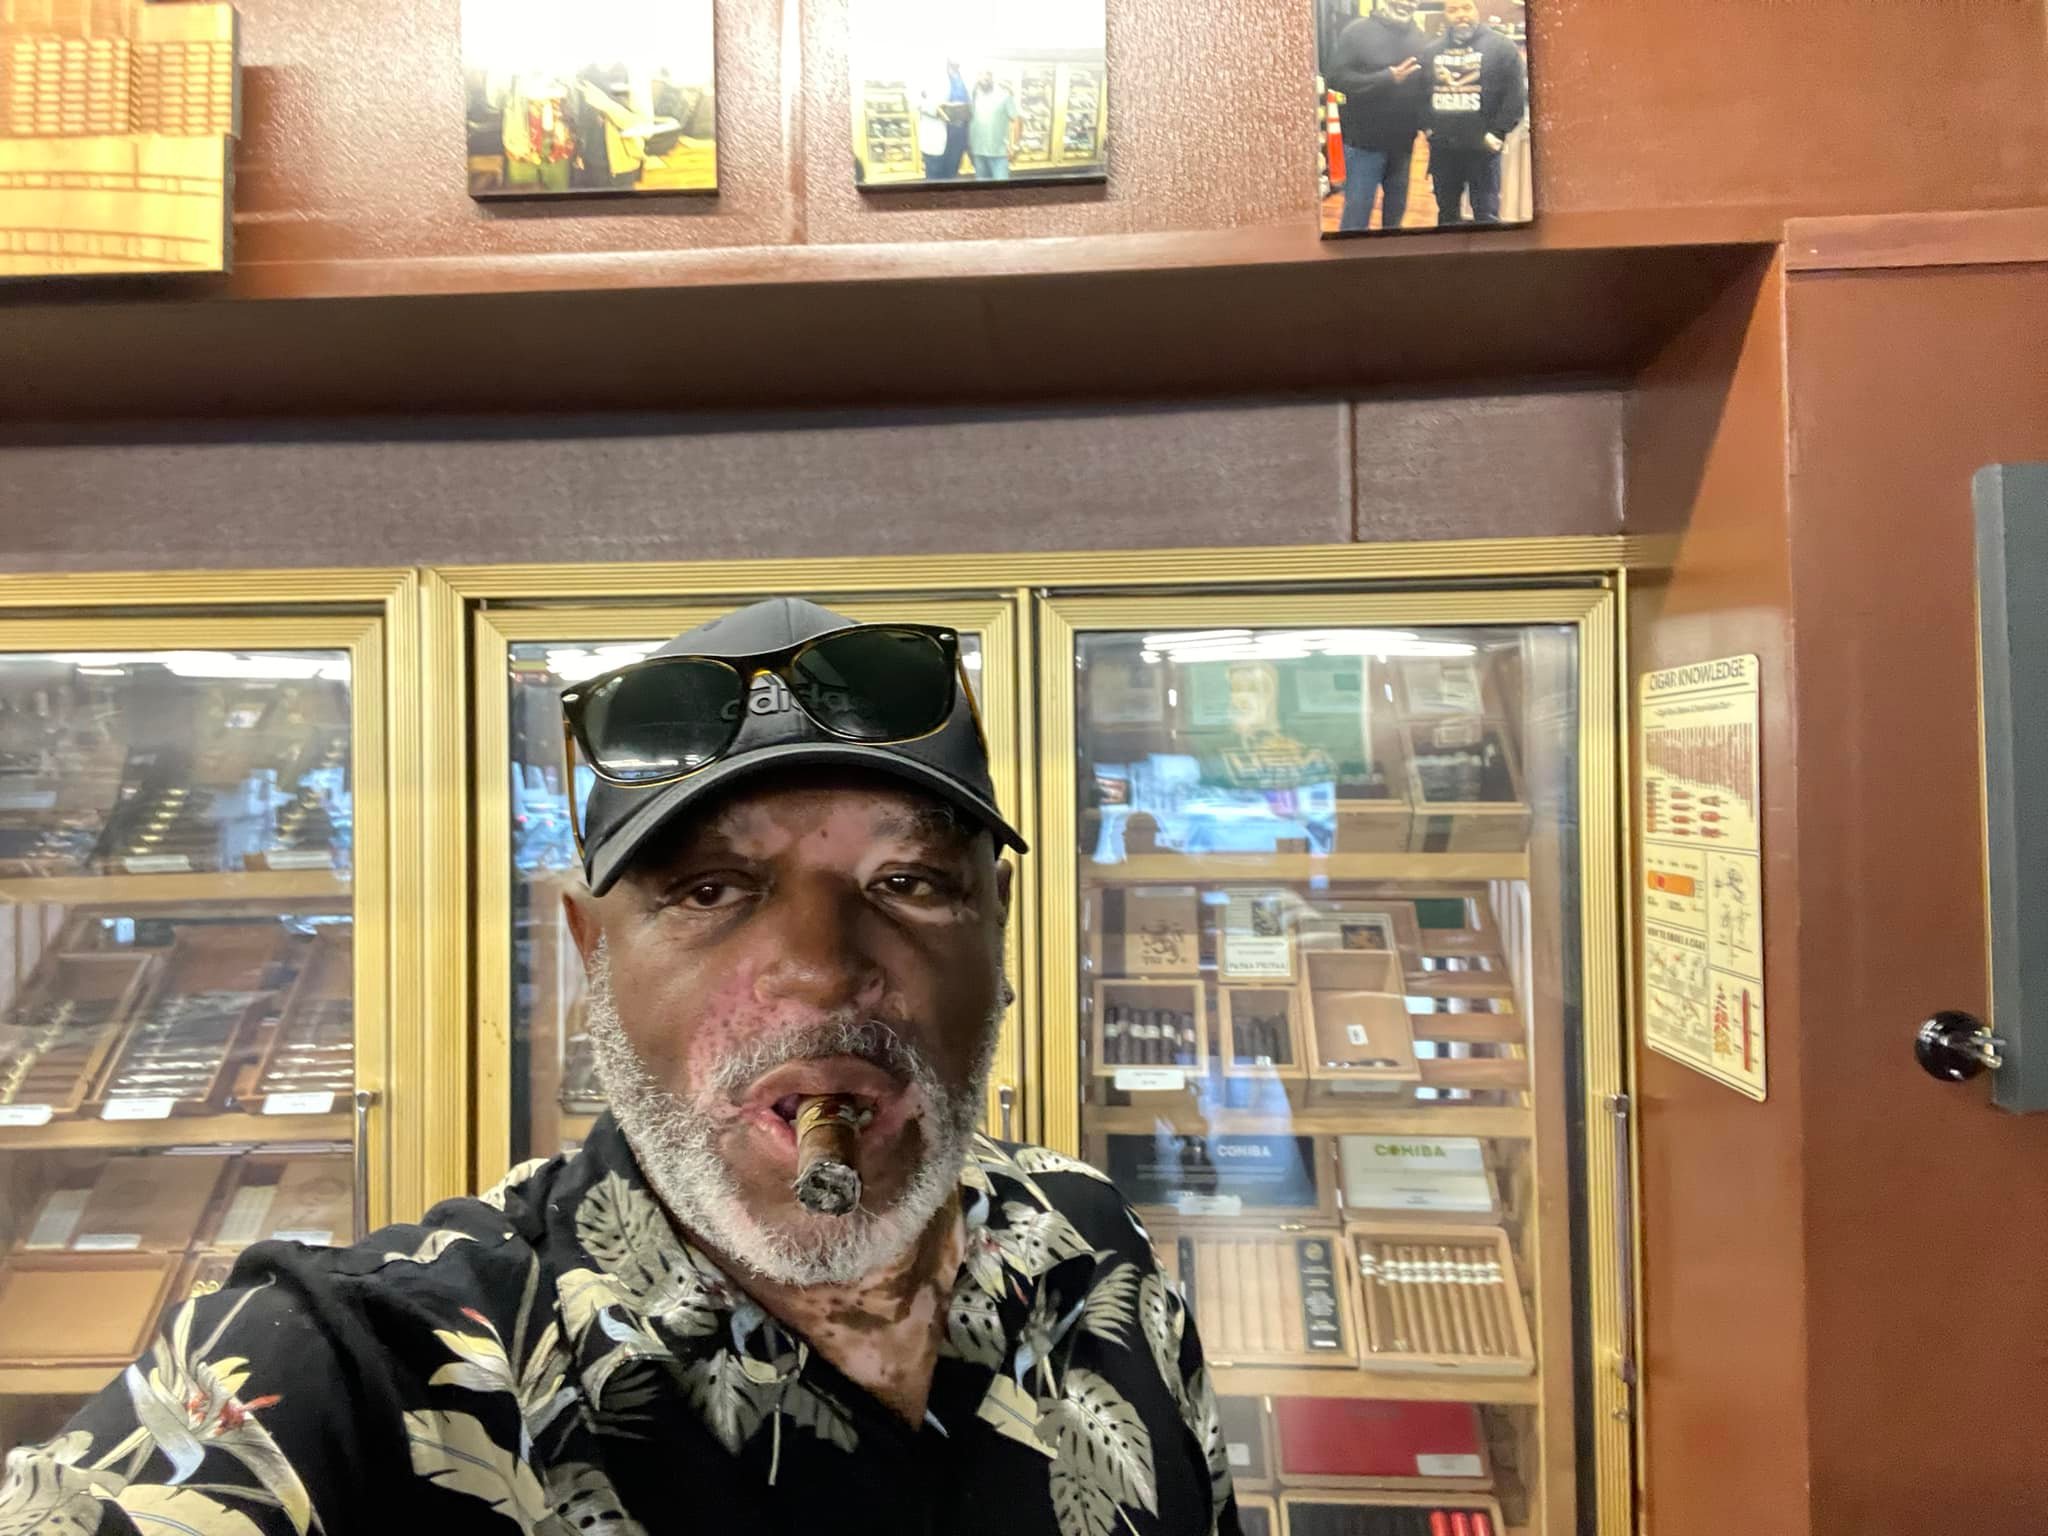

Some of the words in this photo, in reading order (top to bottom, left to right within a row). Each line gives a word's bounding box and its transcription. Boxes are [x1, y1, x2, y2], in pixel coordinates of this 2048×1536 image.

[1649, 670, 1677, 691] CIGAR
[1678, 658, 1744, 686] KNOWLEDGE
[1217, 1143, 1271, 1158] COHIBA
[1375, 1143, 1446, 1158] COHIBA
